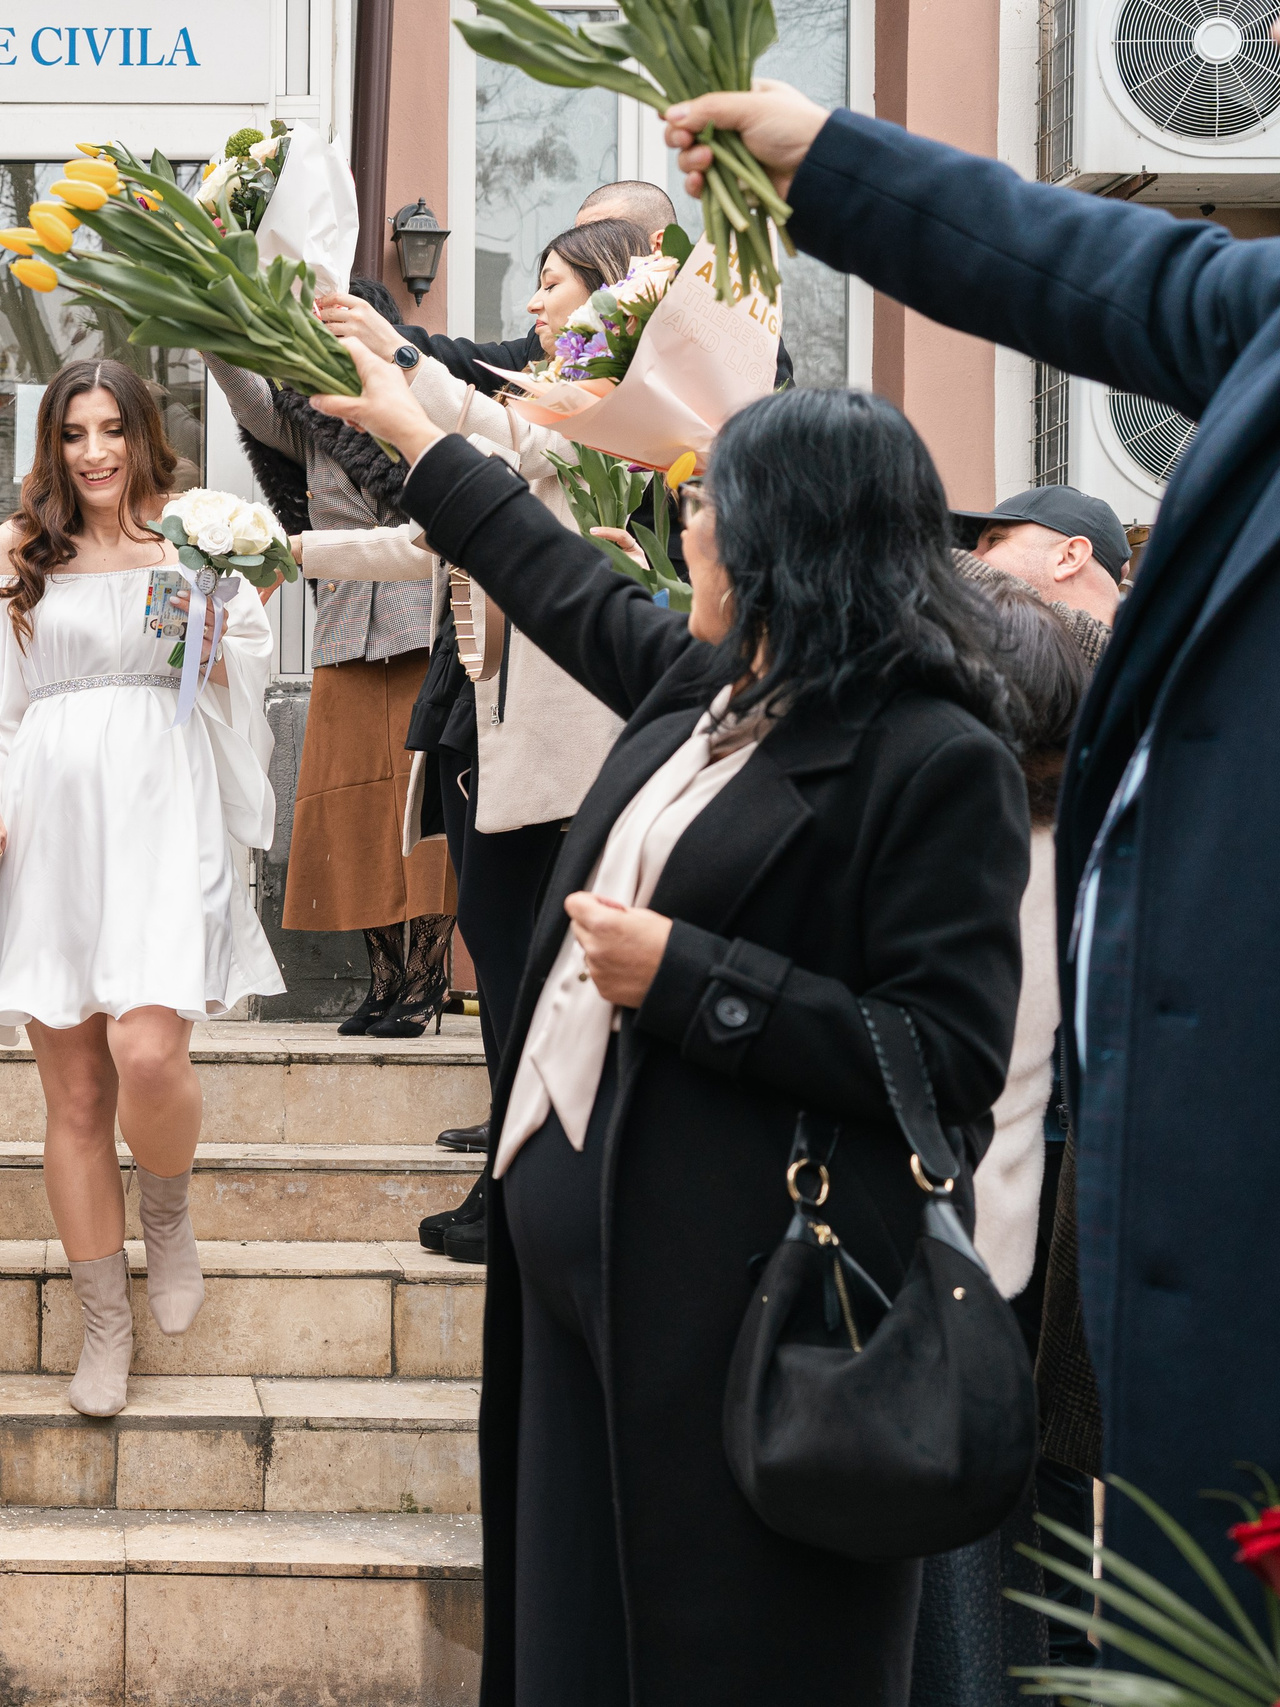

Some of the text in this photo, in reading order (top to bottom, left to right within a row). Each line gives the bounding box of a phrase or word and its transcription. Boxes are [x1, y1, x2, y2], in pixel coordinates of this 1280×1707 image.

[30, 27, 201, 67] CIVILA
[683, 282, 769, 357] THERE'S
[695, 260, 744, 304] AD
[748, 298, 781, 338] LIG
[662, 310, 721, 353] AND
